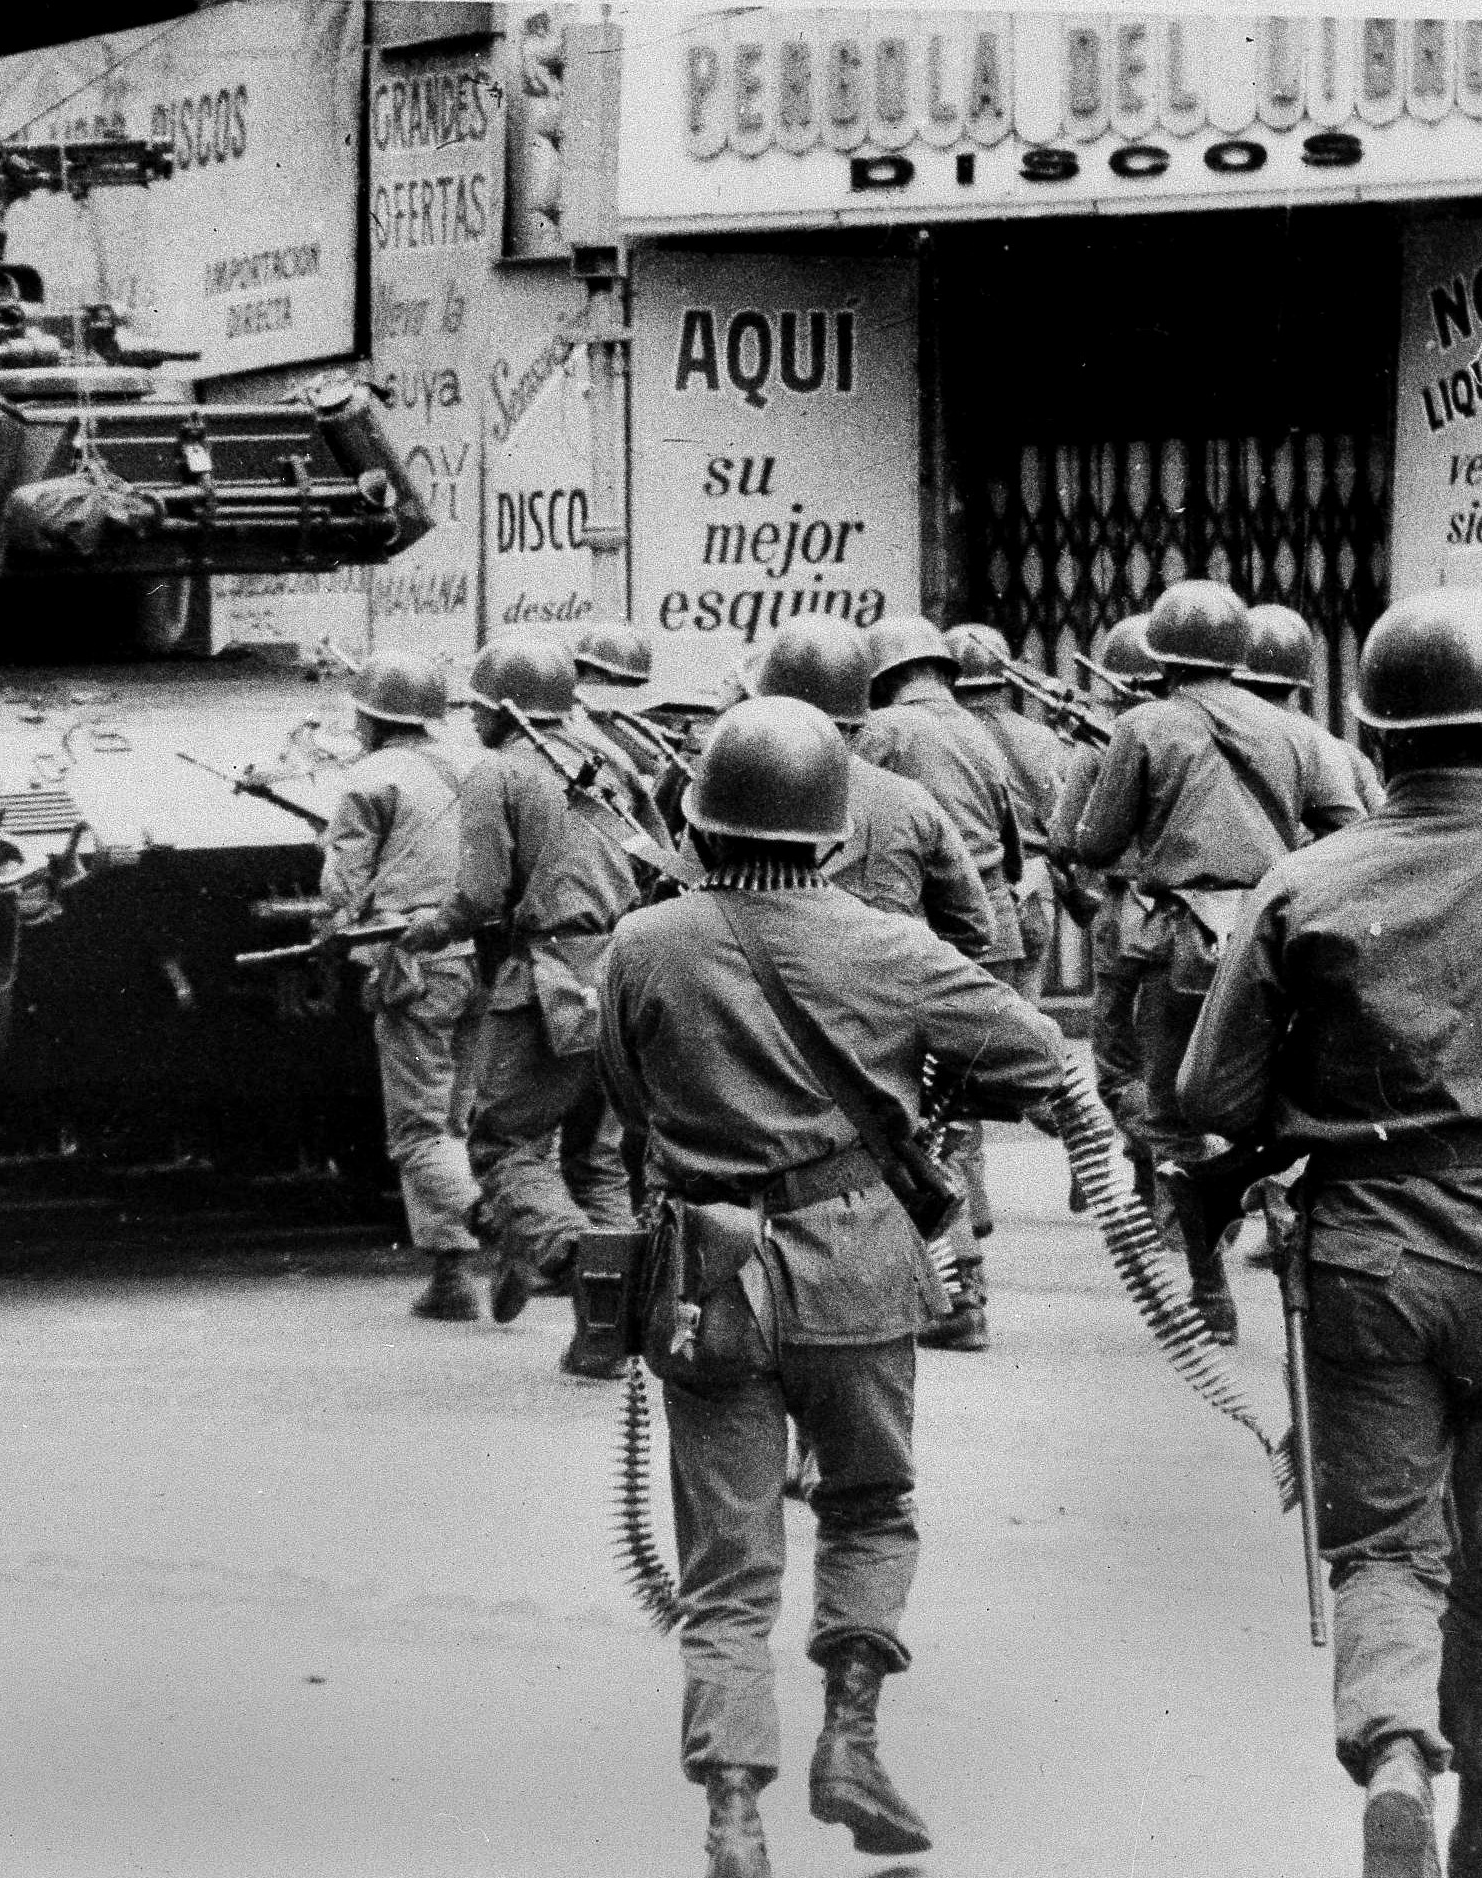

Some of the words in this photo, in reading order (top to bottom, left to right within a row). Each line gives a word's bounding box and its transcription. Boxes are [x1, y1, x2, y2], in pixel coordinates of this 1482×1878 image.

[375, 70, 489, 150] GRANDES
[684, 32, 1006, 134] PERGOLA
[1067, 23, 1198, 119] DEL
[151, 84, 248, 170] DISCOS
[850, 131, 1364, 192] DISCOS
[375, 172, 486, 249] OFERTAS
[381, 369, 462, 427] suya
[702, 455, 777, 497] su
[702, 502, 866, 578] mejor
[502, 591, 593, 625] desde
[658, 572, 887, 643] esquina
